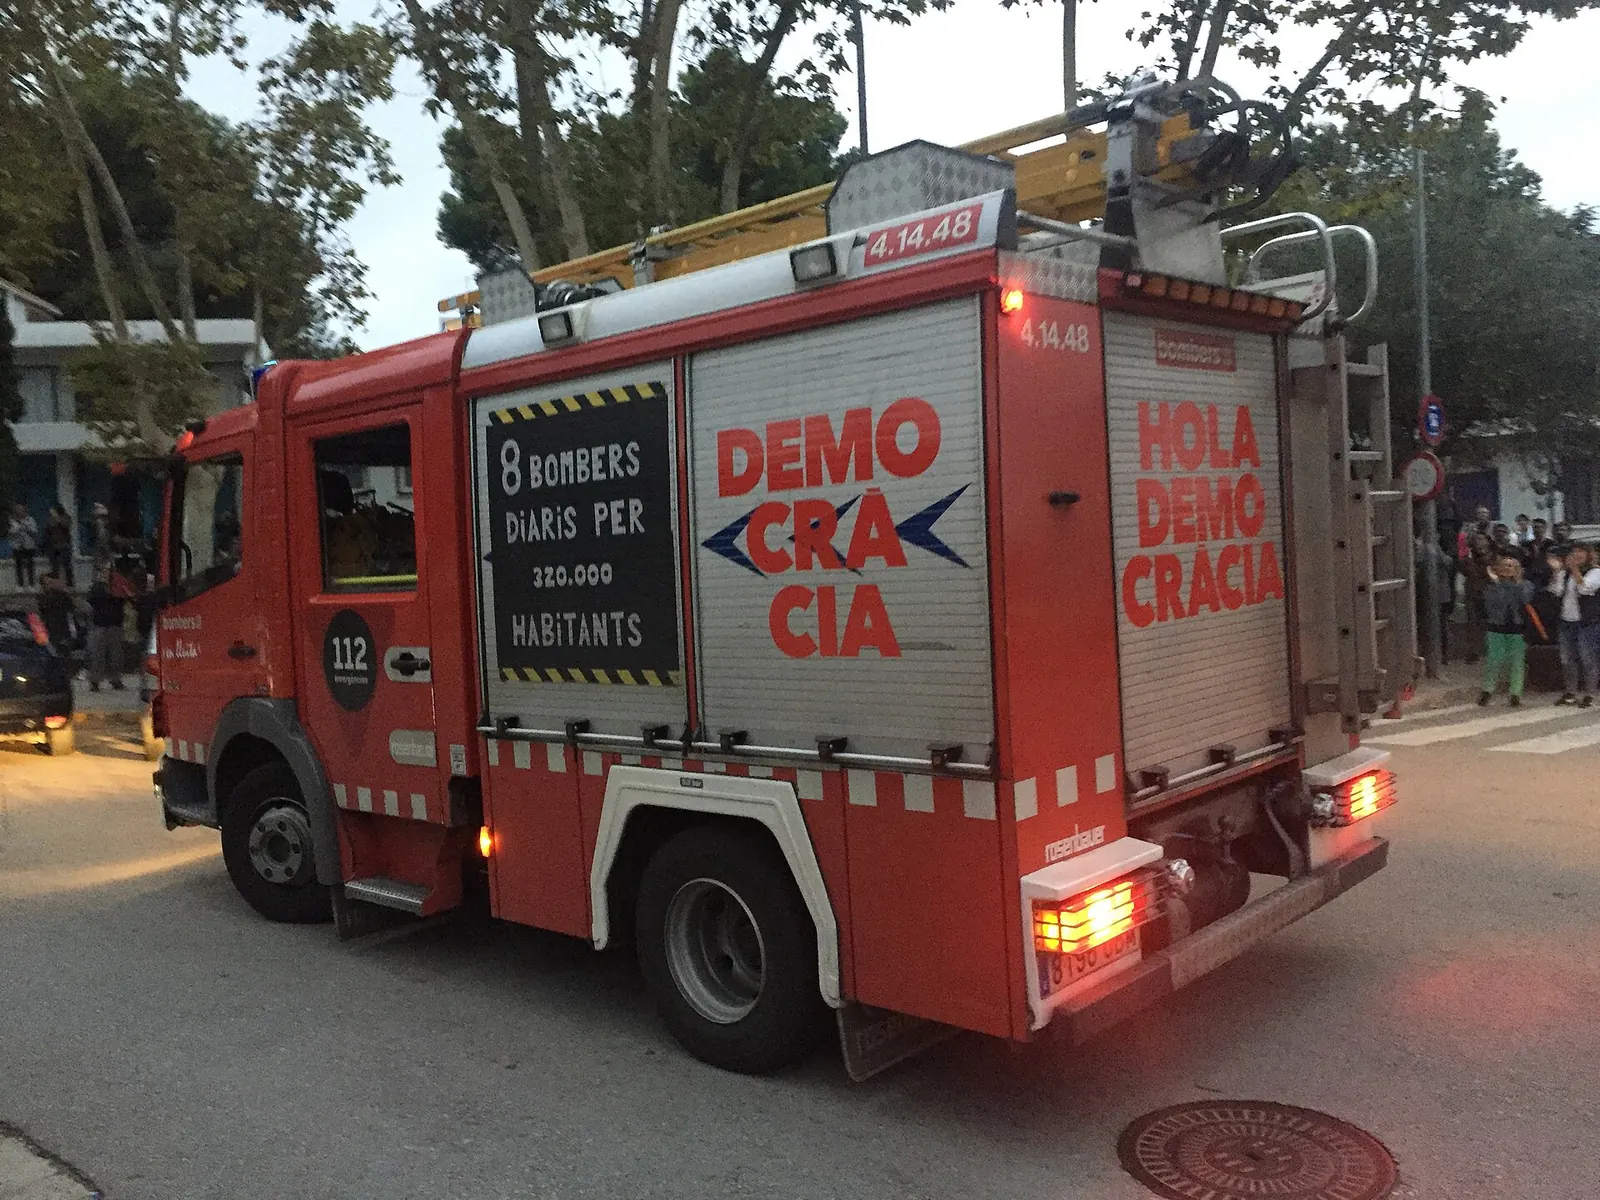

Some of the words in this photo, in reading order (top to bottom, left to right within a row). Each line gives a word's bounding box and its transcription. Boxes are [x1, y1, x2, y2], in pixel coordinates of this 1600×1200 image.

[869, 208, 973, 259] 4.14.48
[1020, 318, 1091, 354] 4.14.48
[717, 397, 942, 498] DEMO
[1137, 401, 1262, 472] HOLA
[500, 438, 522, 496] 8
[528, 440, 640, 489] BOMBERS
[594, 498, 646, 537] PER
[1136, 472, 1266, 549] DEMO
[532, 562, 613, 589] 320.000
[768, 584, 903, 660] CIA
[332, 636, 368, 671] 112
